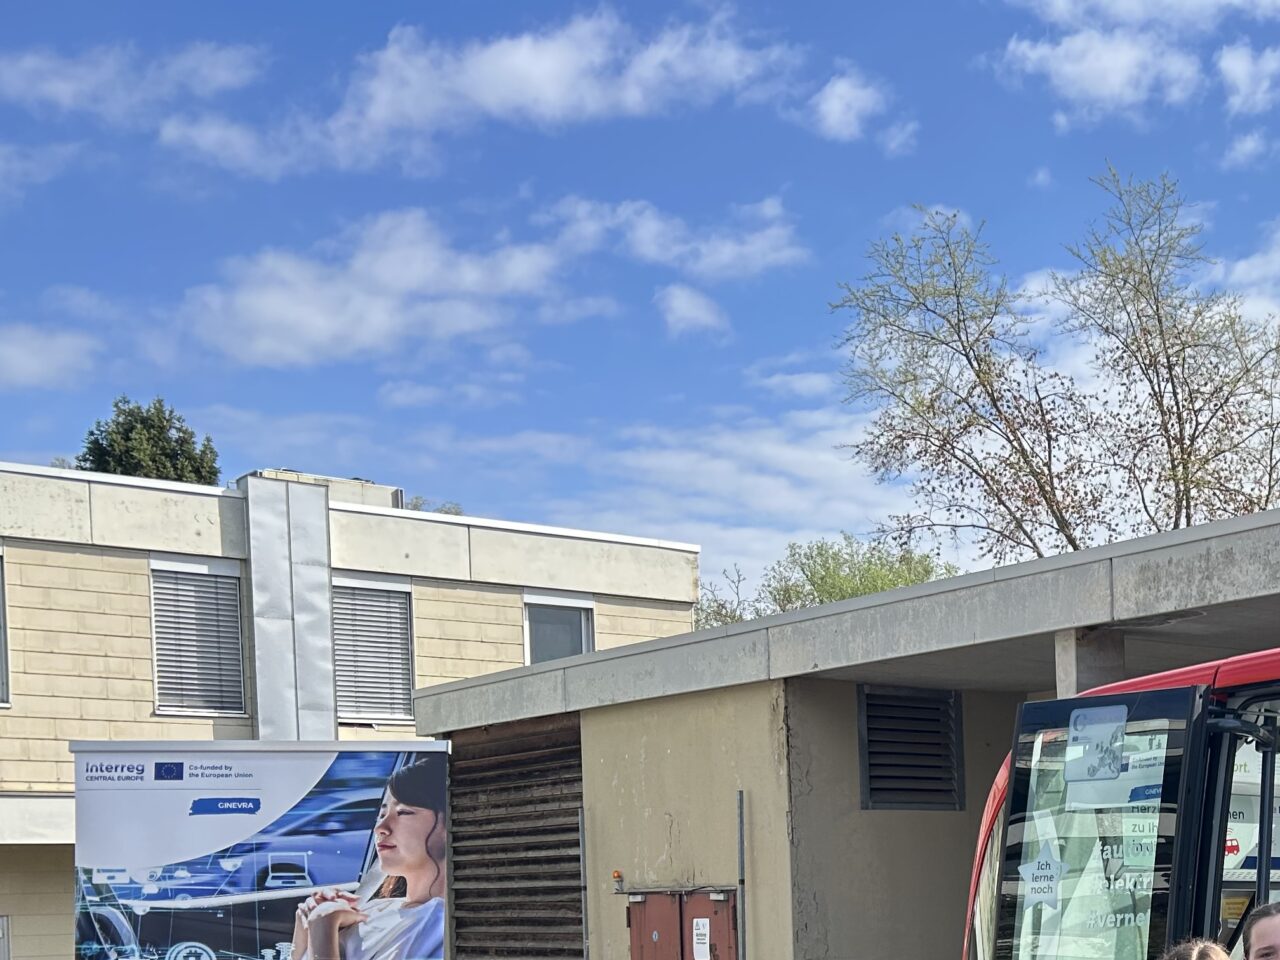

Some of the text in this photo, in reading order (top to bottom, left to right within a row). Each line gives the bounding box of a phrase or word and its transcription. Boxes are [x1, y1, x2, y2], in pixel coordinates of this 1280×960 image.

[85, 761, 145, 775] Interreg
[224, 764, 233, 772] by
[1036, 861, 1051, 871] Ich
[1031, 873, 1055, 882] lerne
[1030, 884, 1053, 894] noch
[1086, 908, 1150, 929] #verne
